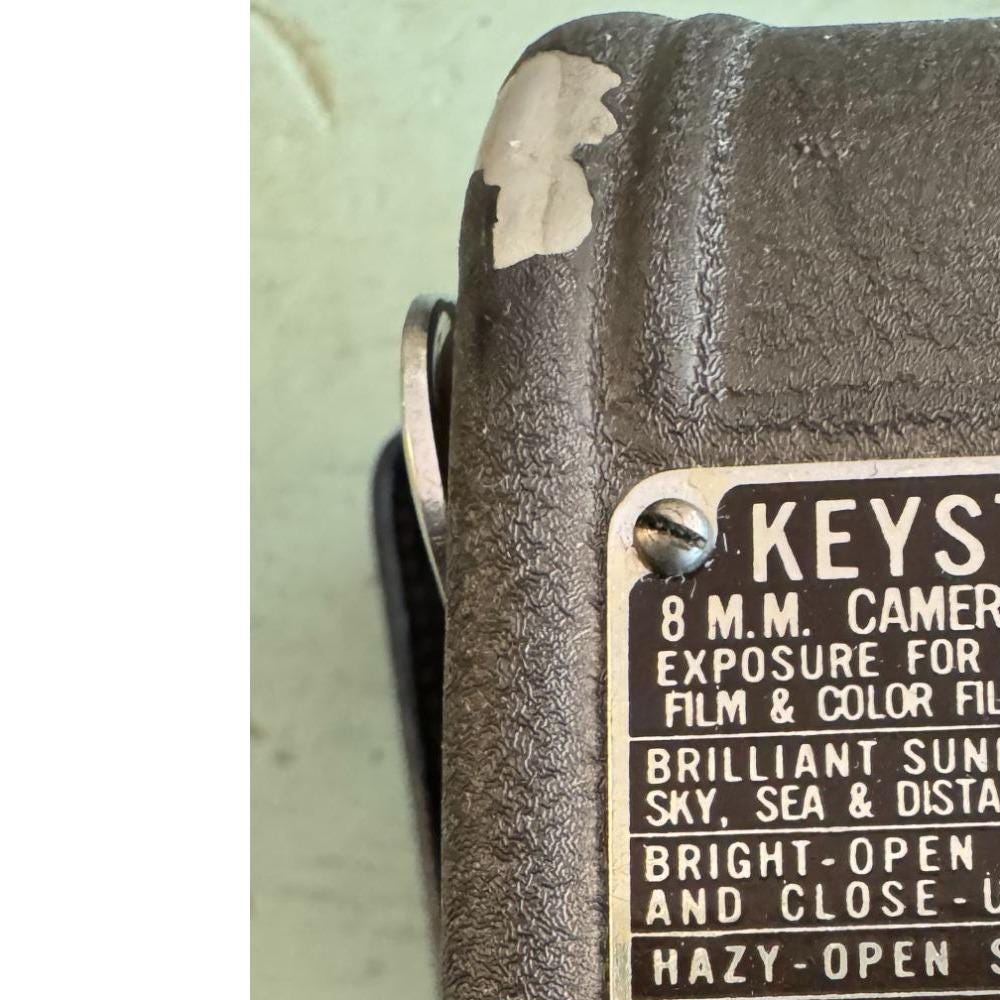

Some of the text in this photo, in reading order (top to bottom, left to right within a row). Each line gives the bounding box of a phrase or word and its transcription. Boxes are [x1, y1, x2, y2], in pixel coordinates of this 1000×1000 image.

[661, 595, 685, 642] 8
[657, 641, 879, 690] EXPOSURE
[907, 638, 980, 675] FOR
[665, 685, 746, 728] FILM
[770, 688, 795, 724] &
[818, 682, 933, 721] COLOR
[647, 738, 877, 784] BRILLIANT
[756, 785, 825, 822] SEA
[849, 782, 874, 819] &
[646, 881, 742, 925] AND
